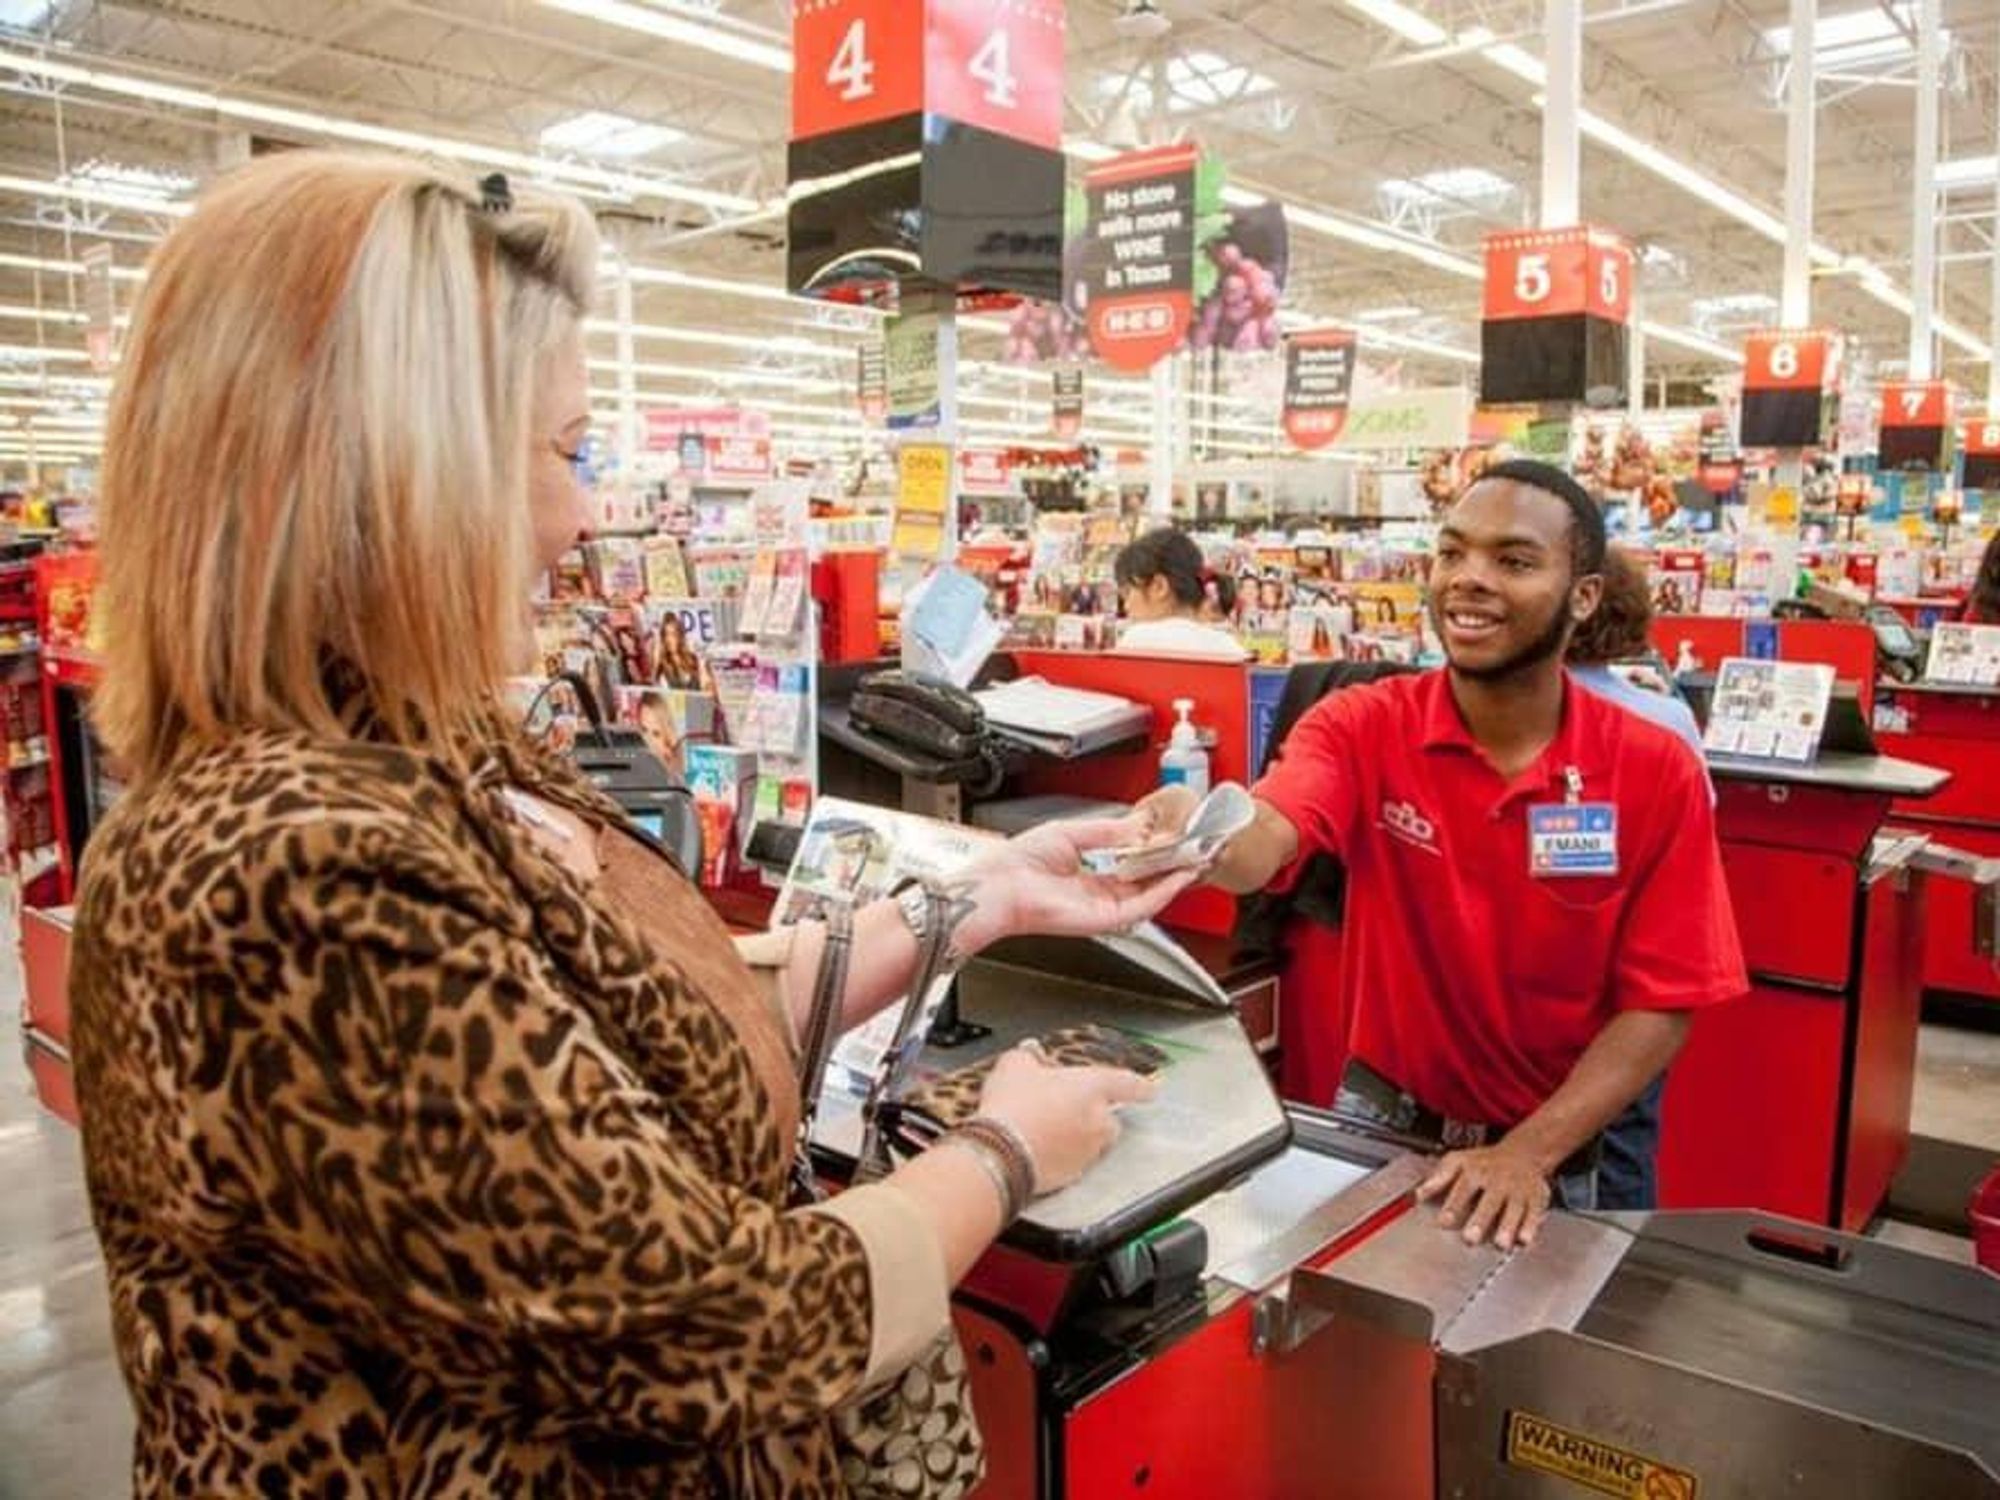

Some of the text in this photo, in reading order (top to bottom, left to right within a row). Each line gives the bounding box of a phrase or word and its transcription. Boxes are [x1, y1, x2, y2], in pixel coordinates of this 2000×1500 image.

[827, 19, 874, 101] 4
[969, 29, 1017, 108] 4
[1104, 184, 1176, 211] No store
[1135, 211, 1182, 231] more
[1124, 264, 1172, 285] Texas
[1514, 253, 1551, 303] 5
[1601, 258, 1618, 305] 5
[1769, 343, 1798, 379] 6
[1901, 391, 1927, 419] 7
[1519, 1419, 1644, 1483] WARNING
